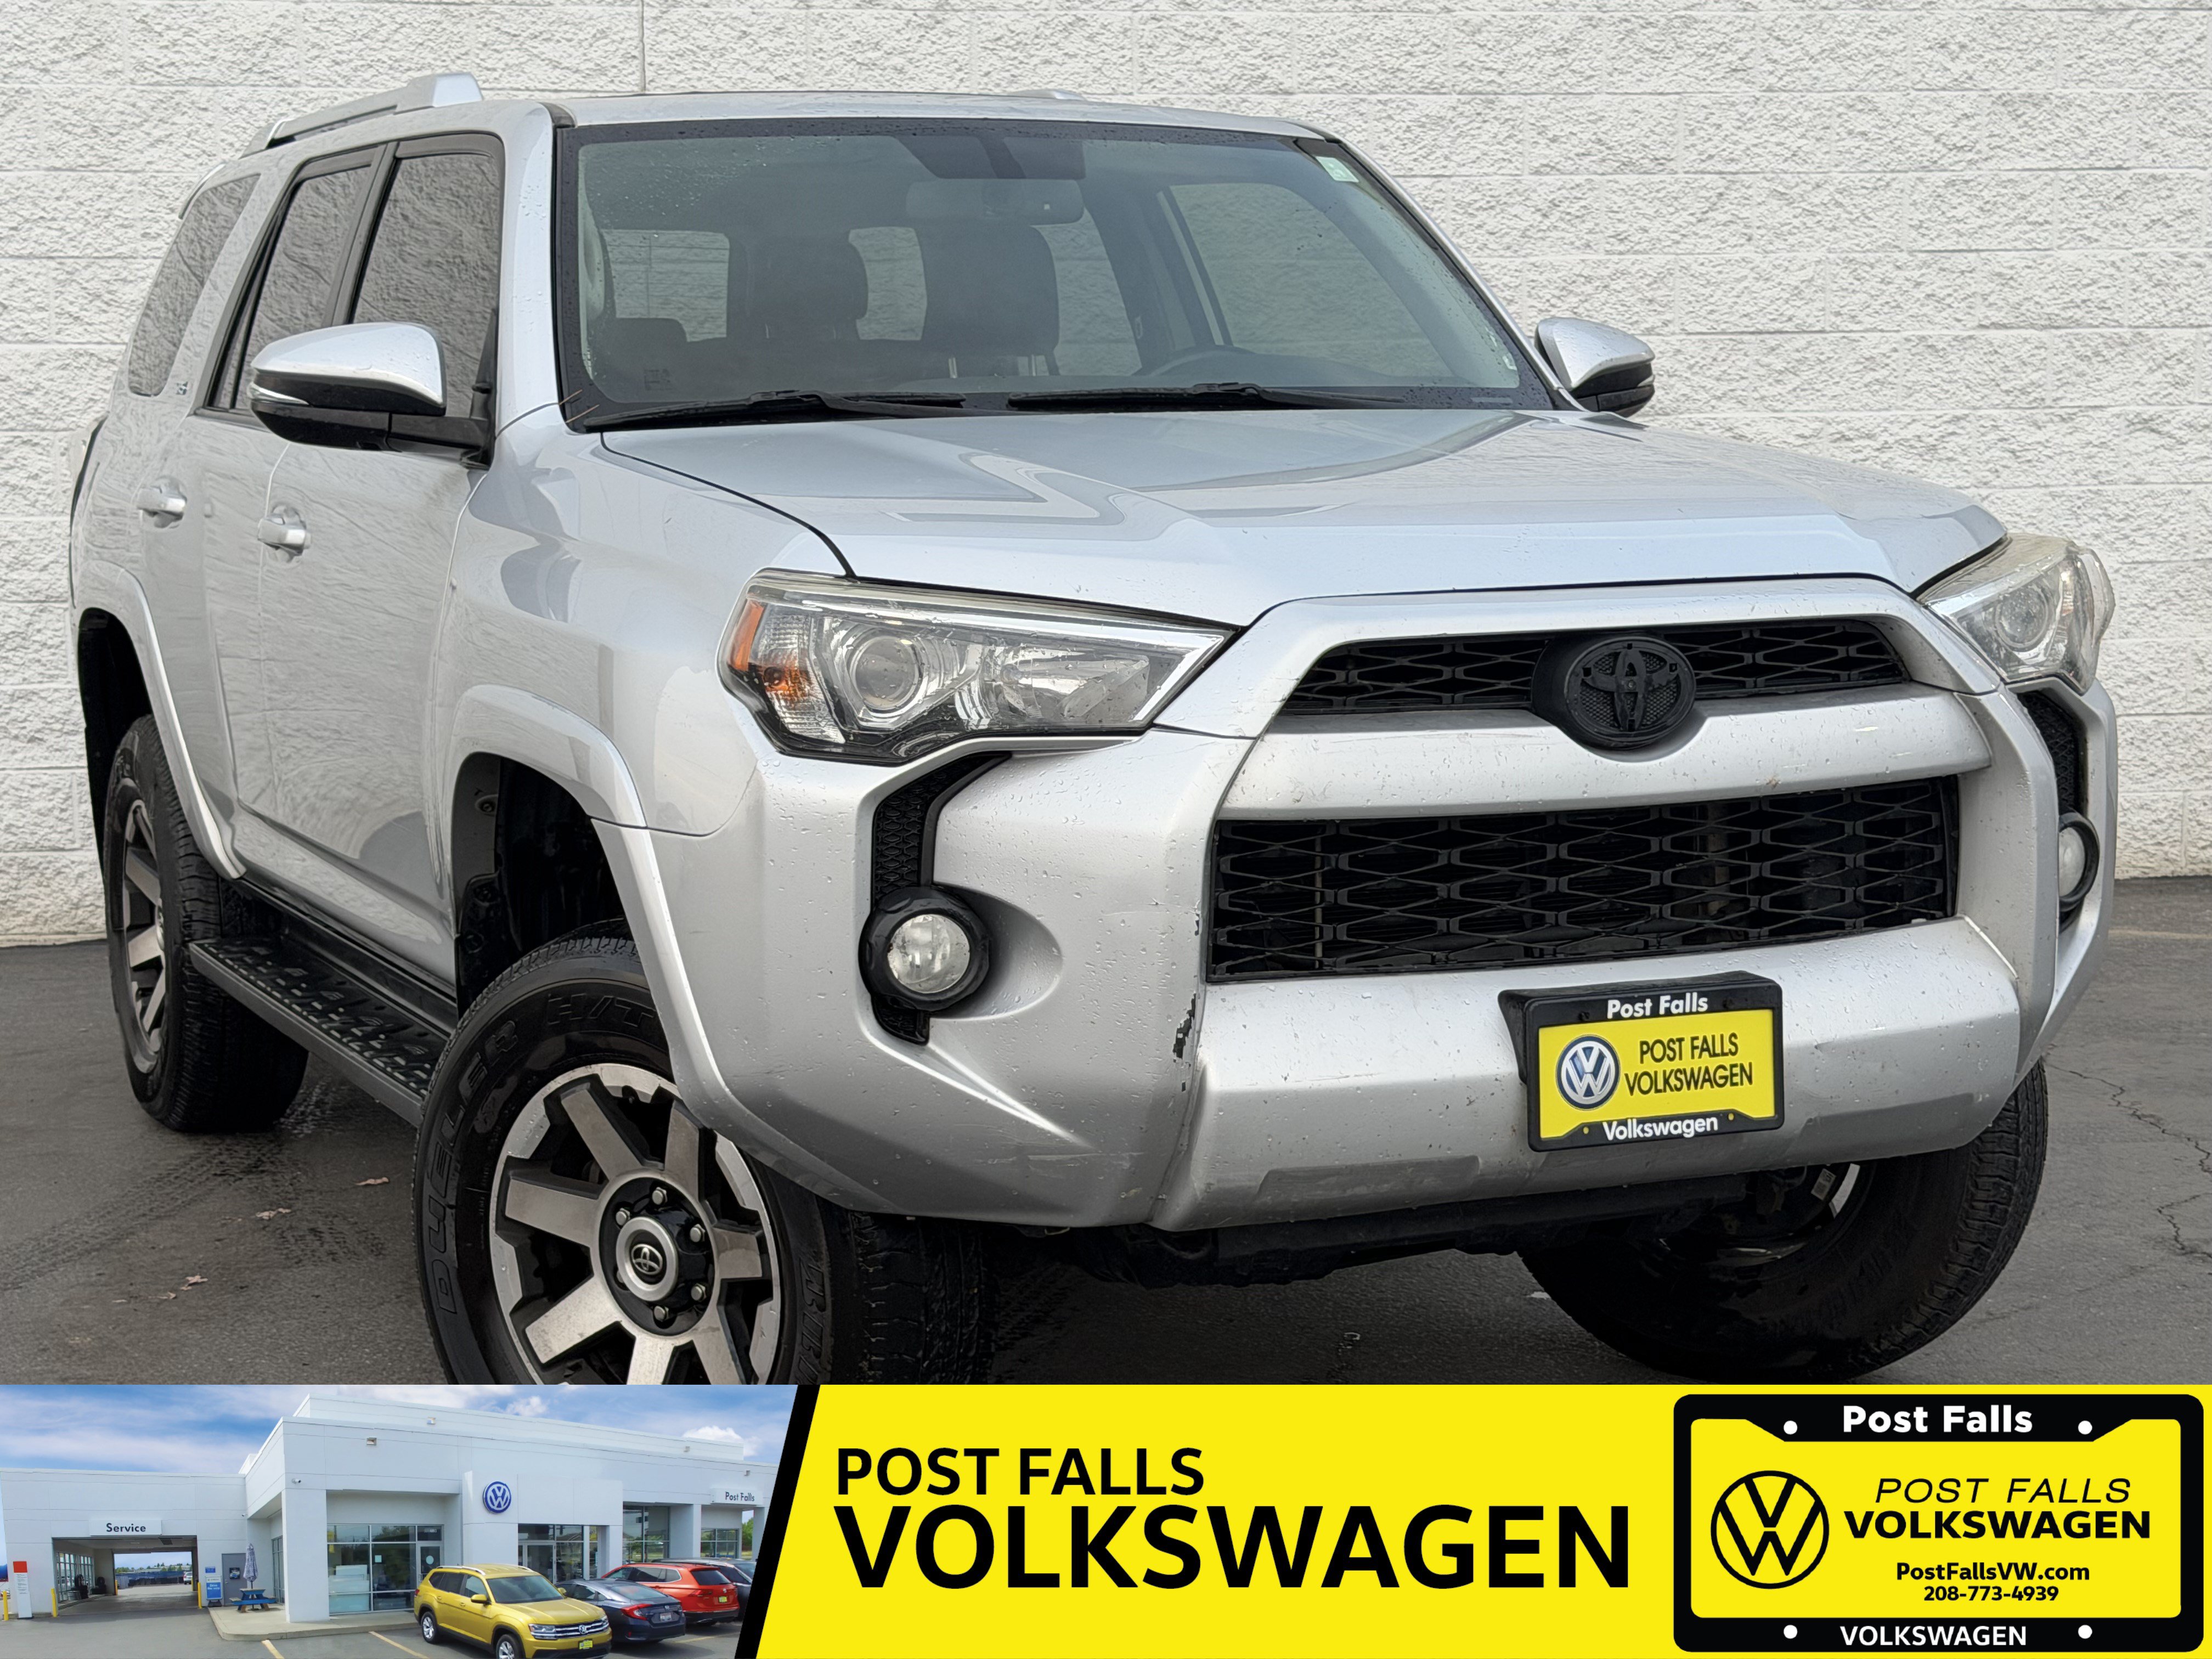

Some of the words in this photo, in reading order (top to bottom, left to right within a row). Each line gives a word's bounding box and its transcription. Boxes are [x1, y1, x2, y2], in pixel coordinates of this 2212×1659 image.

[1607, 1000, 1652, 1019] Post
[1659, 992, 1708, 1015] Falls
[1639, 1038, 1685, 1064] POST
[1690, 1032, 1739, 1059] FALLS
[1624, 1062, 1753, 1096] VOLKSWAGEN
[1602, 1116, 1718, 1141] Volkswagen
[428, 1019, 518, 1314] DUELER
[547, 992, 656, 1028] H/T
[725, 1491, 739, 1501] Post
[740, 1492, 755, 1502] Falls
[106, 1522, 146, 1532] Service
